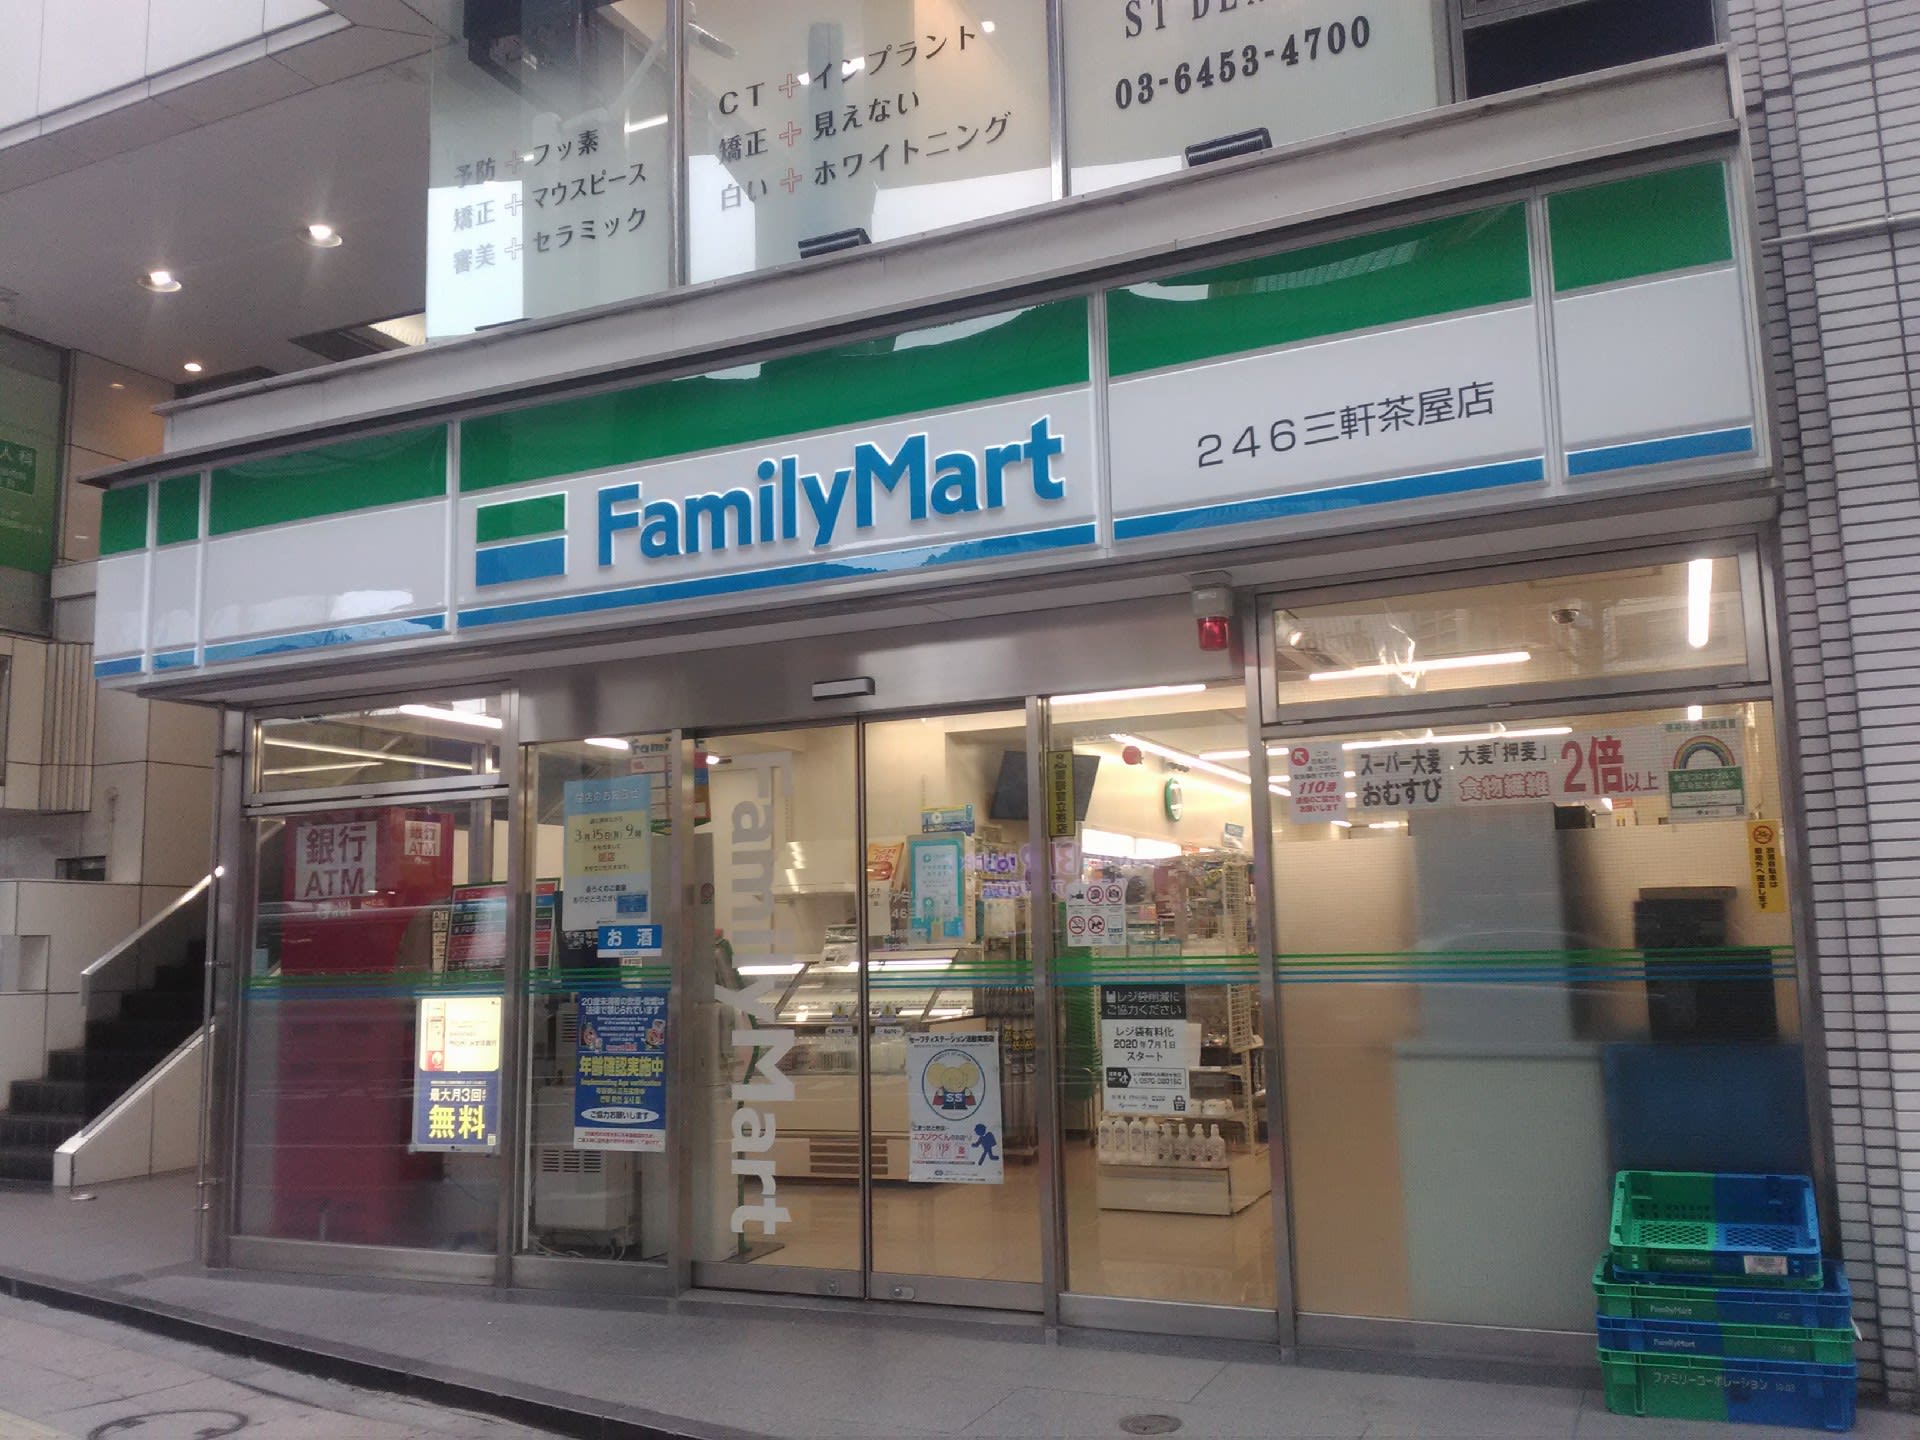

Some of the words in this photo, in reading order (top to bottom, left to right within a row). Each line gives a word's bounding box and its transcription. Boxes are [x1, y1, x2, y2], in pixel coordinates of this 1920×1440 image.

[719, 82, 765, 115] CT
[813, 25, 976, 90] インプラント
[1115, 15, 1371, 109] 03-6453-4700
[718, 129, 768, 165] 矯正
[813, 91, 919, 141] 見えない
[454, 158, 496, 189] 予防
[533, 128, 600, 167] フッ素
[721, 178, 768, 212] 白い
[814, 111, 1011, 186] ホワイトニング
[453, 200, 496, 232] 矯正
[532, 163, 647, 209] マウスピース
[533, 207, 646, 254] セラミック
[1197, 381, 1495, 469] 246三軒茶屋店
[597, 414, 1067, 567] FamilyMart
[1361, 748, 1441, 776] スーパー大麦
[1459, 740, 1548, 766] 大麦「押麦」
[1362, 777, 1443, 807] おむすび
[1459, 770, 1550, 801] 食物繊維
[306, 825, 367, 865] 銀行
[304, 868, 366, 897] ATM
[606, 927, 654, 947] お酒
[1106, 1004, 1182, 1016] ご協力ください
[1127, 1051, 1164, 1062] スタート
[428, 1104, 486, 1140] 無料
